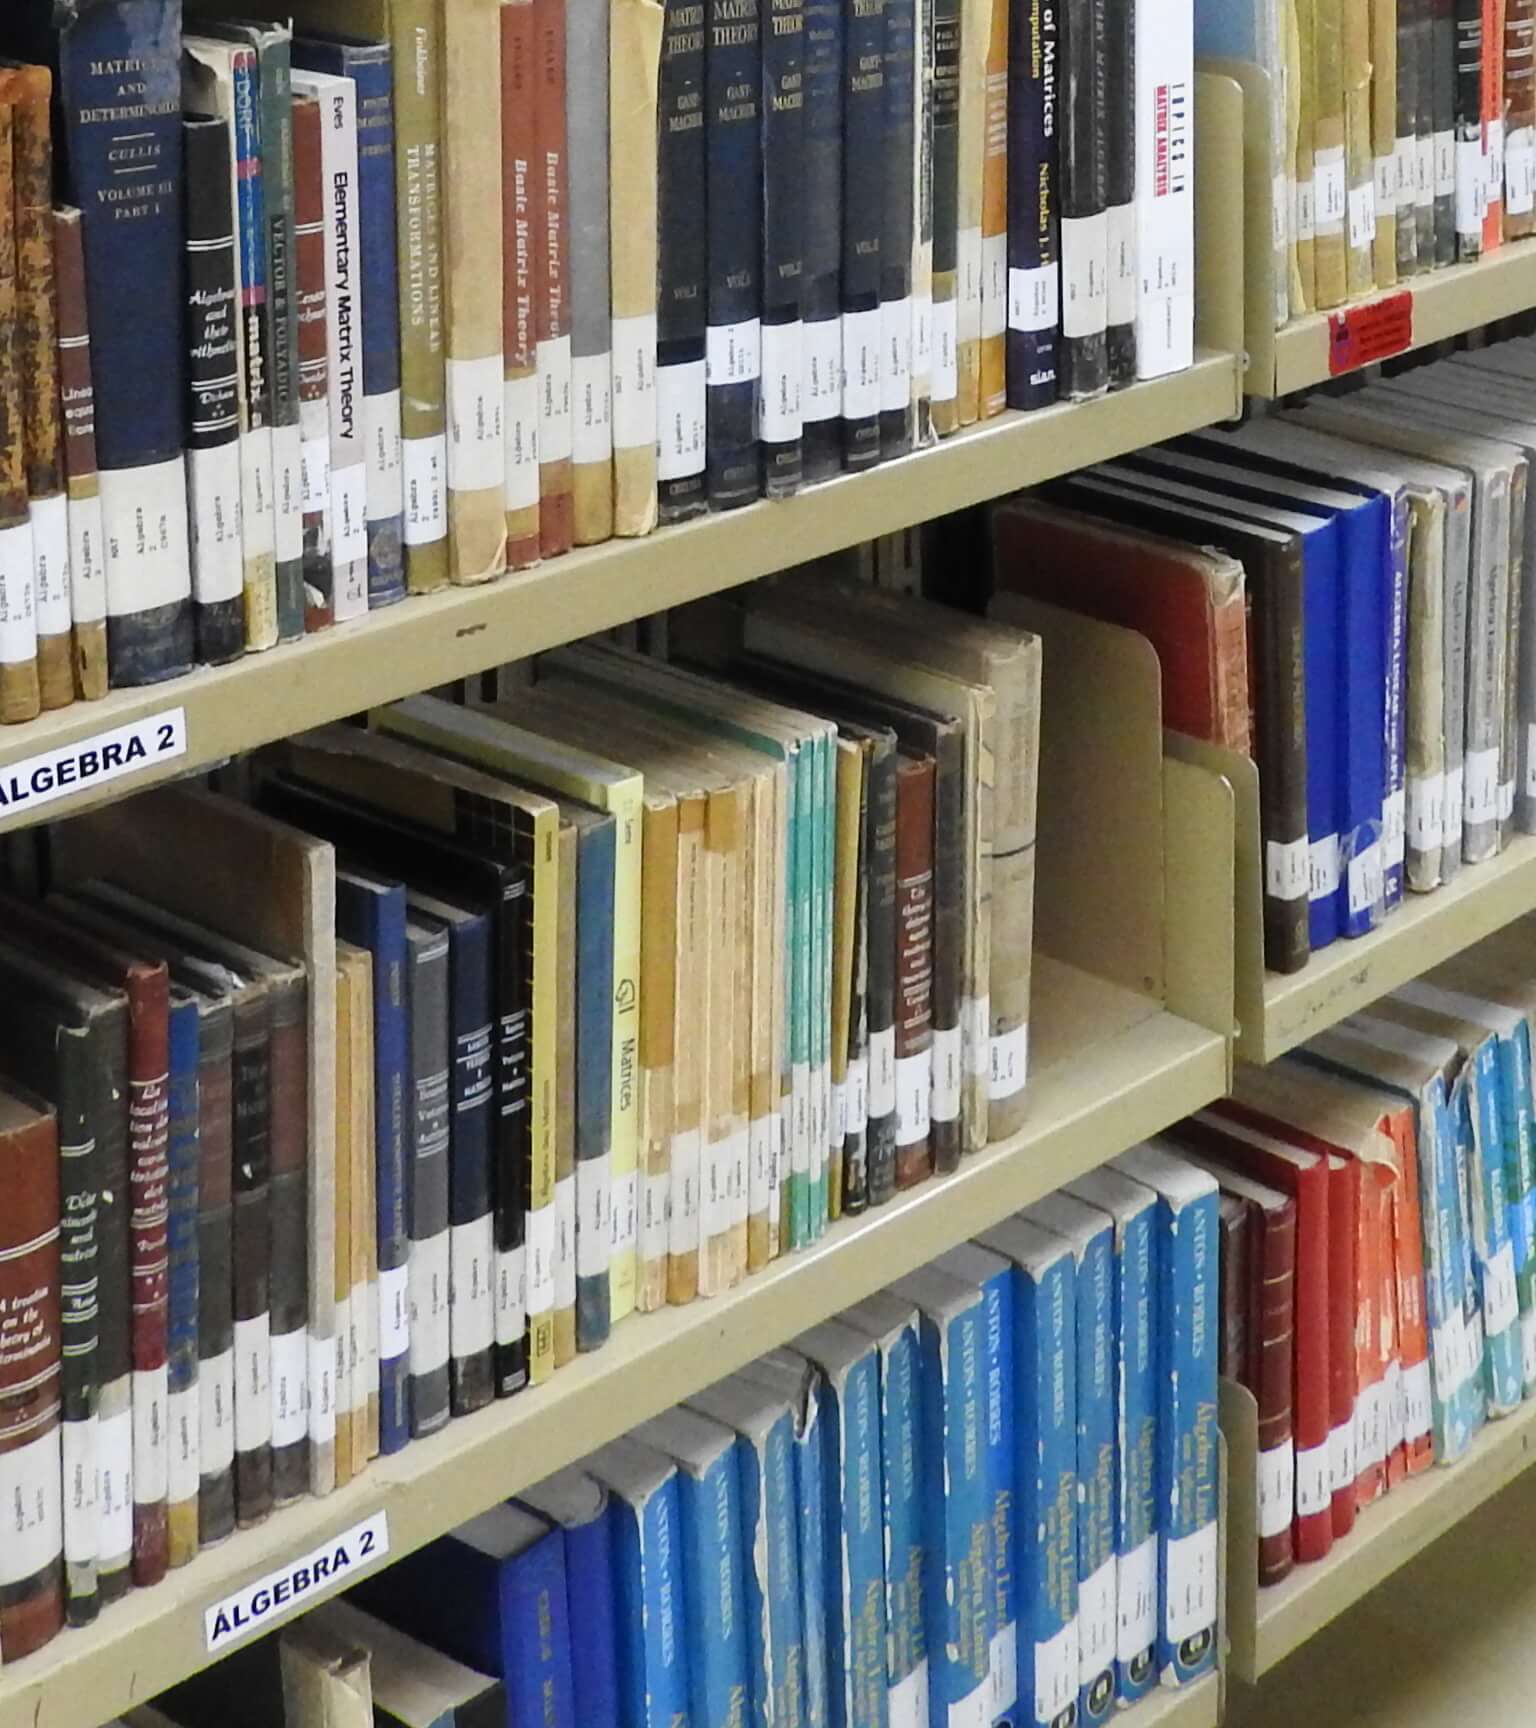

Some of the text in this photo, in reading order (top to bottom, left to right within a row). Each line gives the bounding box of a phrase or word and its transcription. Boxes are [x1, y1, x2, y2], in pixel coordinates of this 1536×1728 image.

[1044, 8, 1055, 34] of
[116, 83, 146, 97] AND
[1043, 39, 1056, 138] Matrices
[333, 94, 345, 130] Eves
[108, 144, 161, 161] CULLIS
[96, 183, 152, 203] VOLUME
[514, 160, 528, 215] Basic
[546, 152, 560, 207] Basic
[1038, 161, 1051, 231] Nicholas
[114, 204, 149, 219] PART
[406, 144, 424, 326] TRANSFORMATIONS
[333, 171, 355, 441] Elementary Matrix Theory
[156, 723, 176, 751] 2
[211, 1530, 376, 1640] ÁLGEBRA 2
